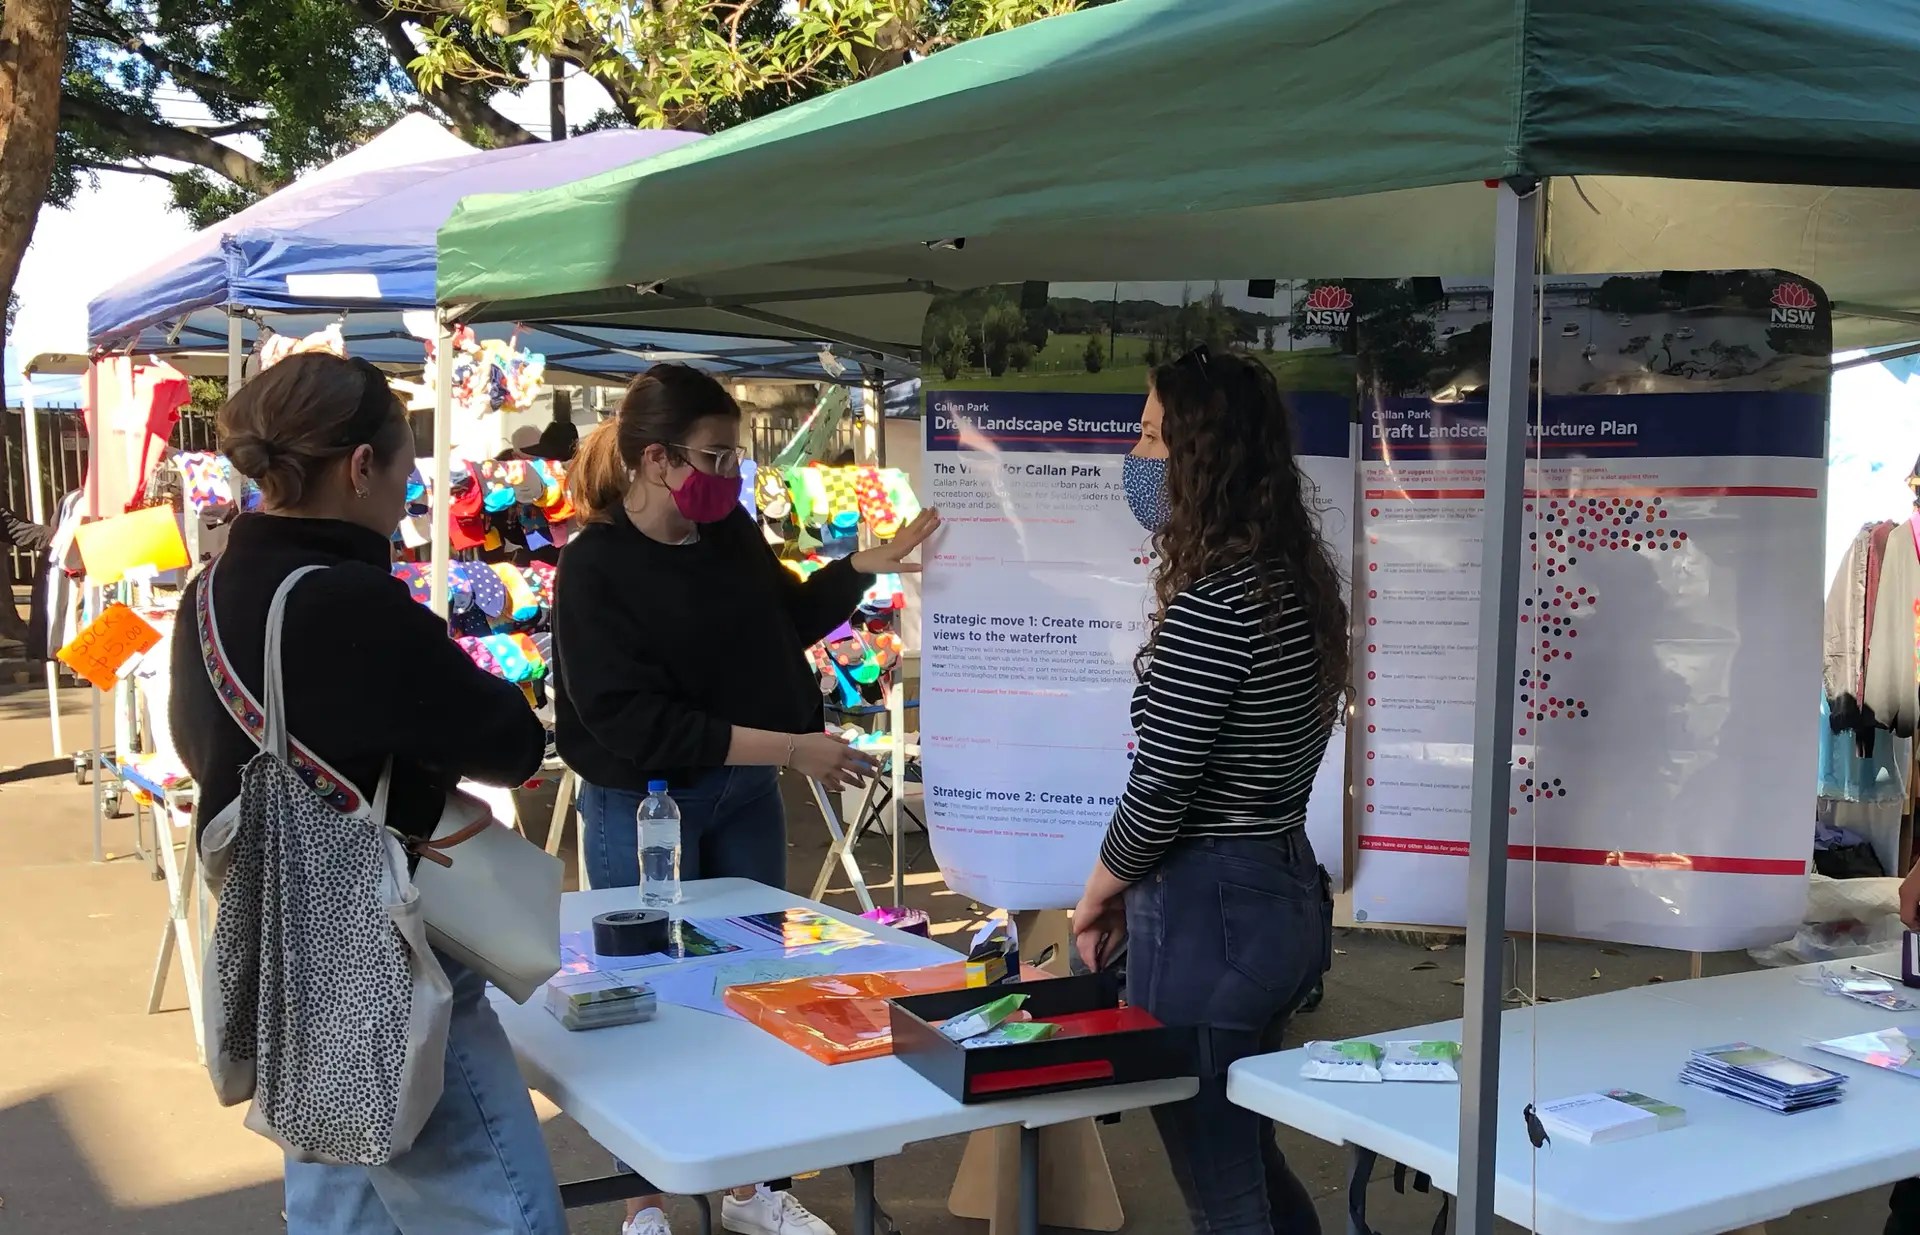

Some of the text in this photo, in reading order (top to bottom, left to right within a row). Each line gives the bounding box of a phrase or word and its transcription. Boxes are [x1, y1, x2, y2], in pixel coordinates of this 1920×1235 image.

[1306, 311, 1350, 325] NSW
[1771, 308, 1815, 324] NSW
[934, 403, 989, 411] Callan Park
[1371, 410, 1431, 419] Callan Park
[977, 416, 1063, 434] Landscape
[1067, 417, 1142, 433] Structure
[1372, 421, 1638, 438] Draft Landsca tructure Plan
[933, 463, 956, 474] The
[1025, 464, 1067, 476] Callan
[1071, 465, 1101, 477] Park
[933, 478, 957, 487] Callan
[959, 479, 978, 487] Park
[1051, 480, 1077, 489] urban
[933, 490, 973, 498] recreation
[1111, 492, 1120, 500] to
[933, 501, 966, 511] heritage
[968, 501, 984, 509] and
[933, 613, 987, 627] Strategic
[990, 617, 1025, 627] move
[1029, 616, 1038, 627] 1:
[1042, 616, 1084, 628] Create
[1088, 619, 1123, 629] more
[933, 630, 1078, 644] views to the waterfront
[88, 625, 142, 669] $5.00
[932, 785, 982, 800] Strategic
[986, 790, 1020, 801] move
[1025, 791, 1036, 802] 2:
[1040, 791, 1083, 804] Create
[1087, 794, 1095, 804] a
